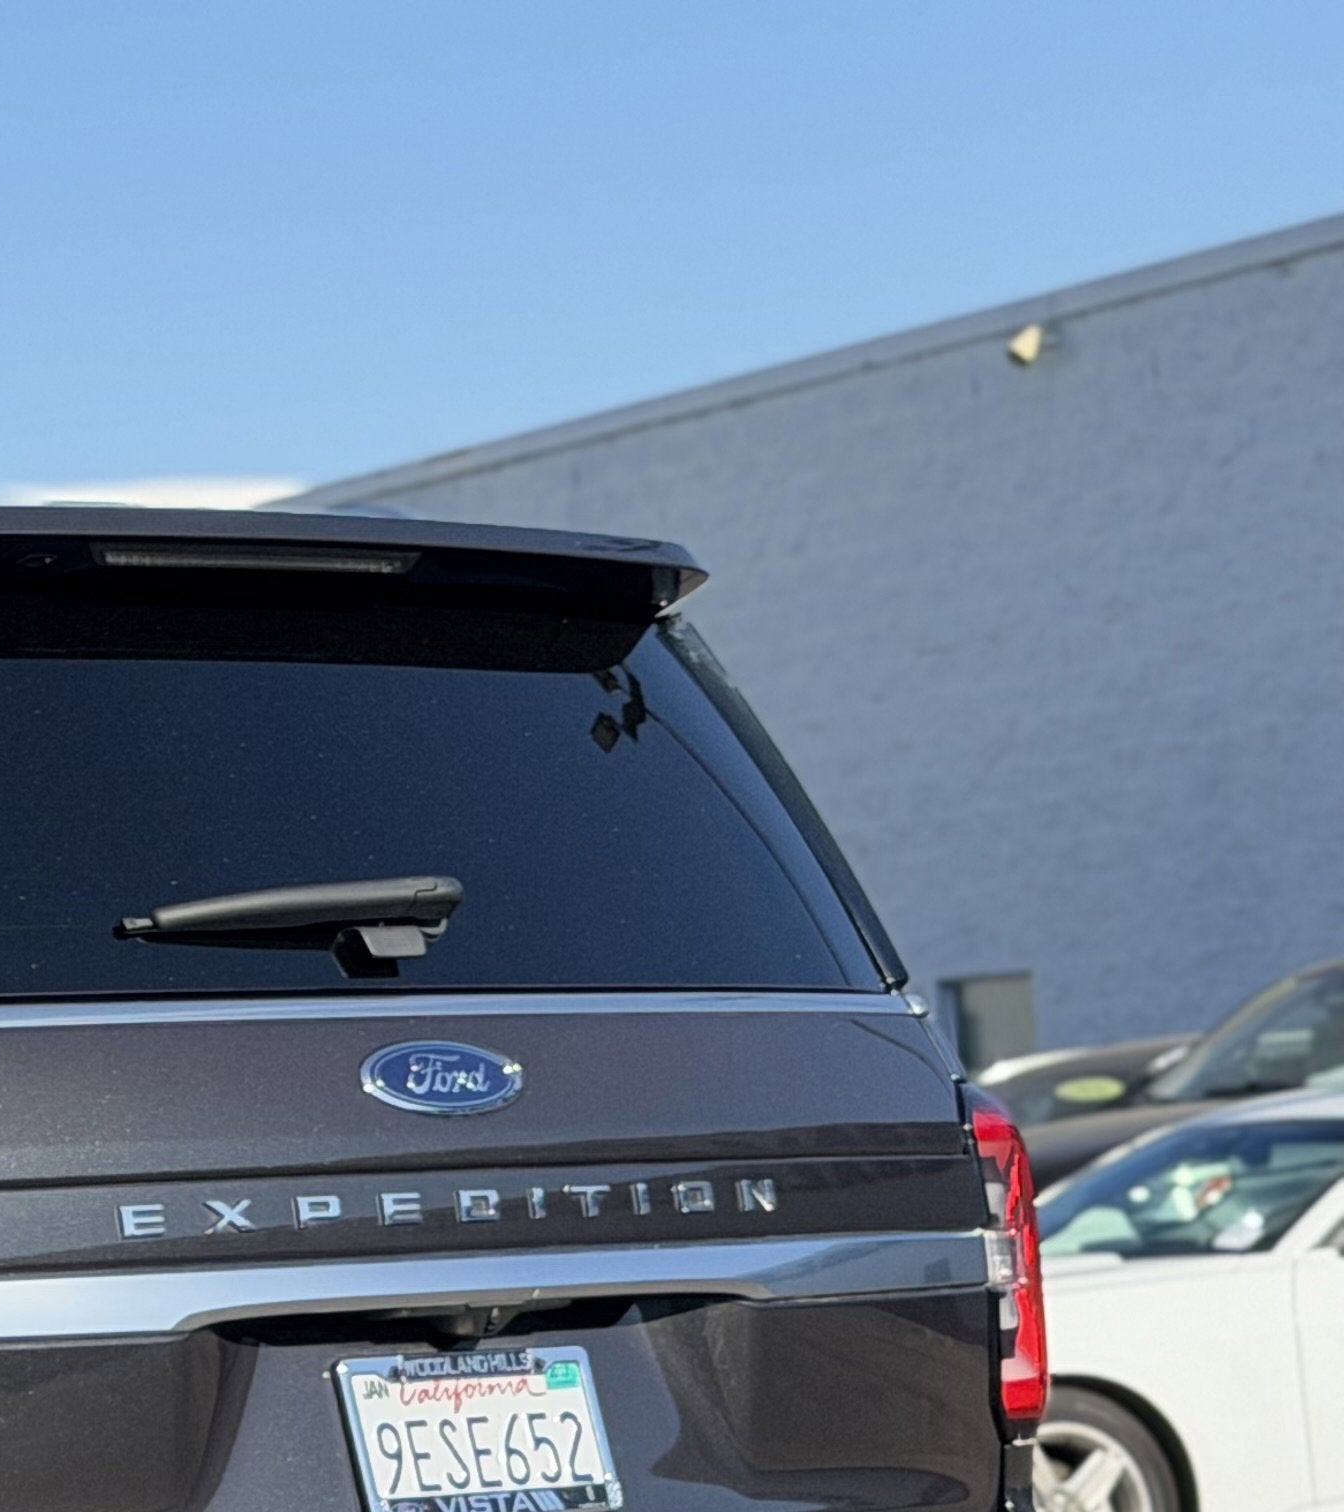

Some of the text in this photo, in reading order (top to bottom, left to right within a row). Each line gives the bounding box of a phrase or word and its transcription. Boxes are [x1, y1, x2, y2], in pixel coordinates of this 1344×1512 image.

[406, 1053, 491, 1094] Ford
[116, 1178, 778, 1240] EXPEDITION
[402, 1352, 530, 1377] WOODLAND HILLS
[362, 1379, 390, 1400] JAN
[376, 1411, 594, 1495] 9ESE652
